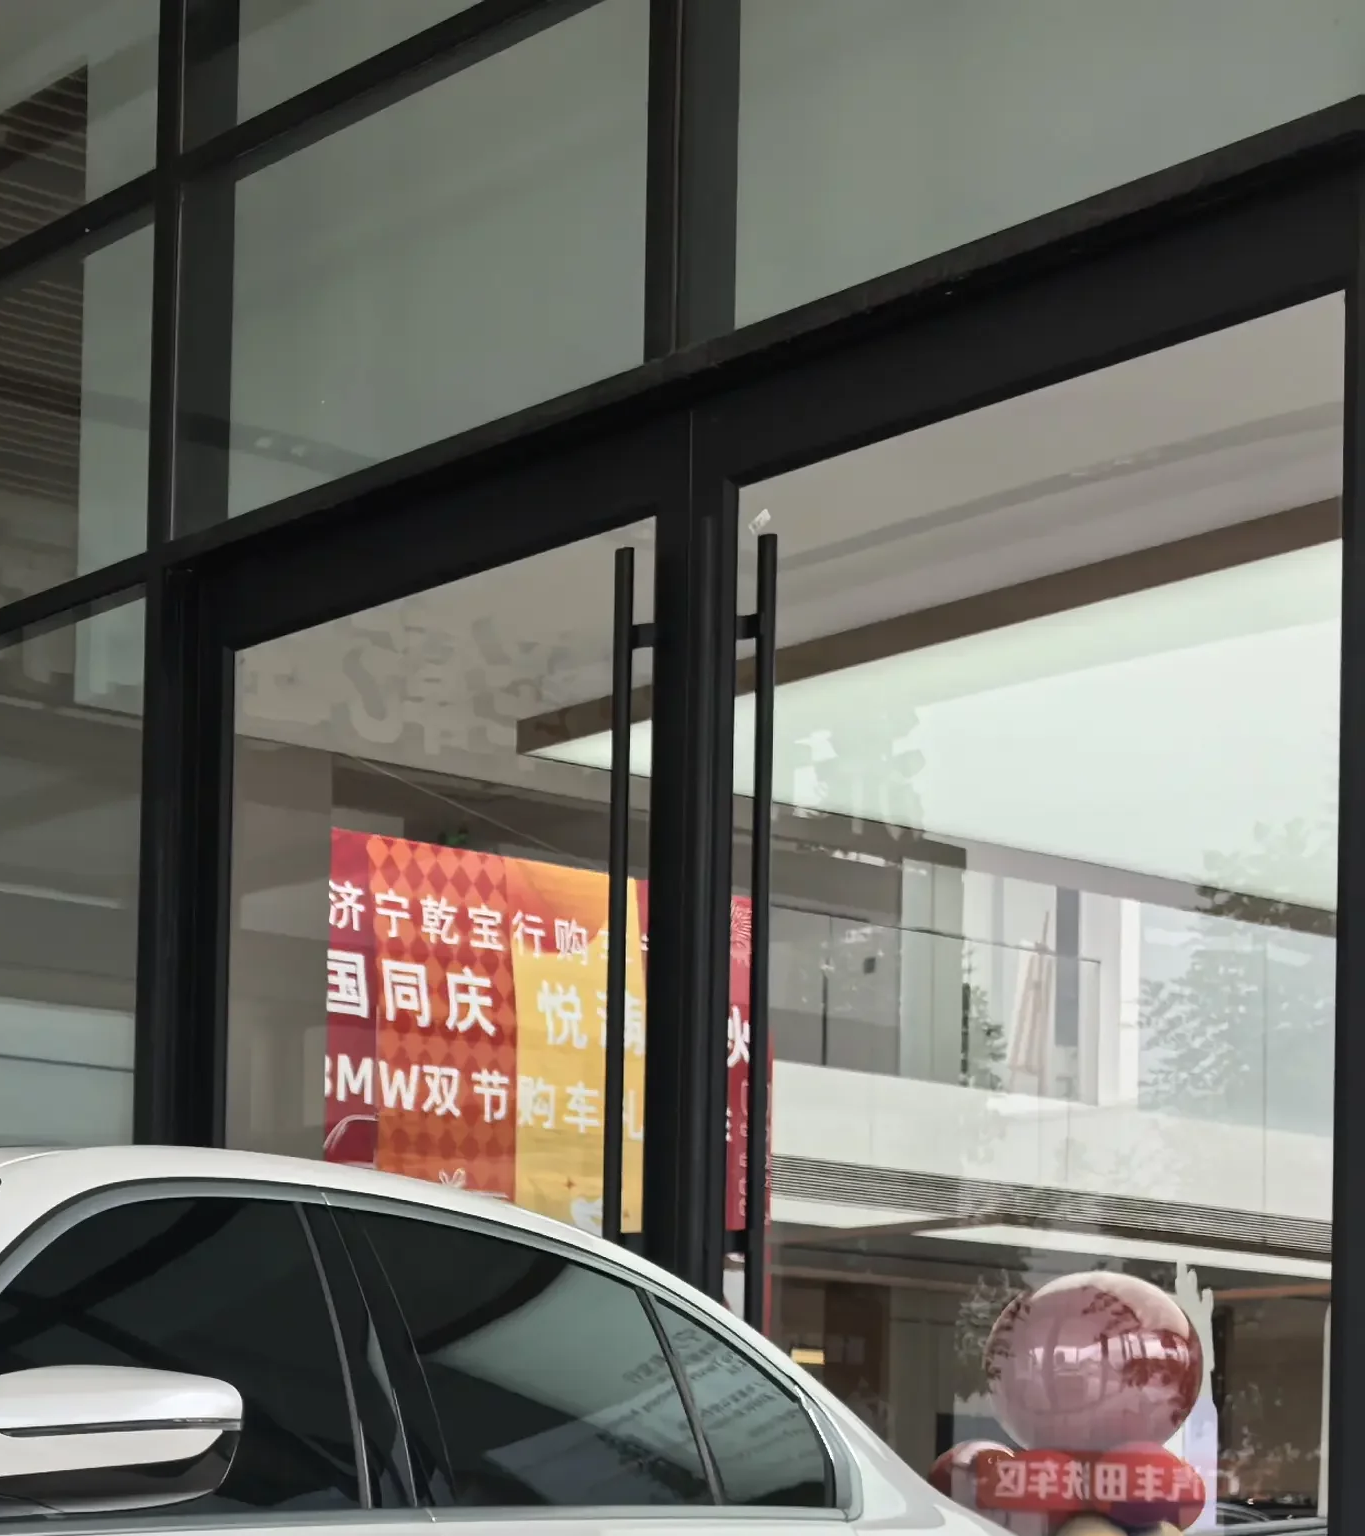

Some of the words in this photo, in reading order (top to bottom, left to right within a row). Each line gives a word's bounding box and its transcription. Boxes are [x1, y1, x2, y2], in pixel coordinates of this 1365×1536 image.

[328, 879, 648, 966] 济宁乾宝行购
[326, 949, 496, 1036] 国同庆
